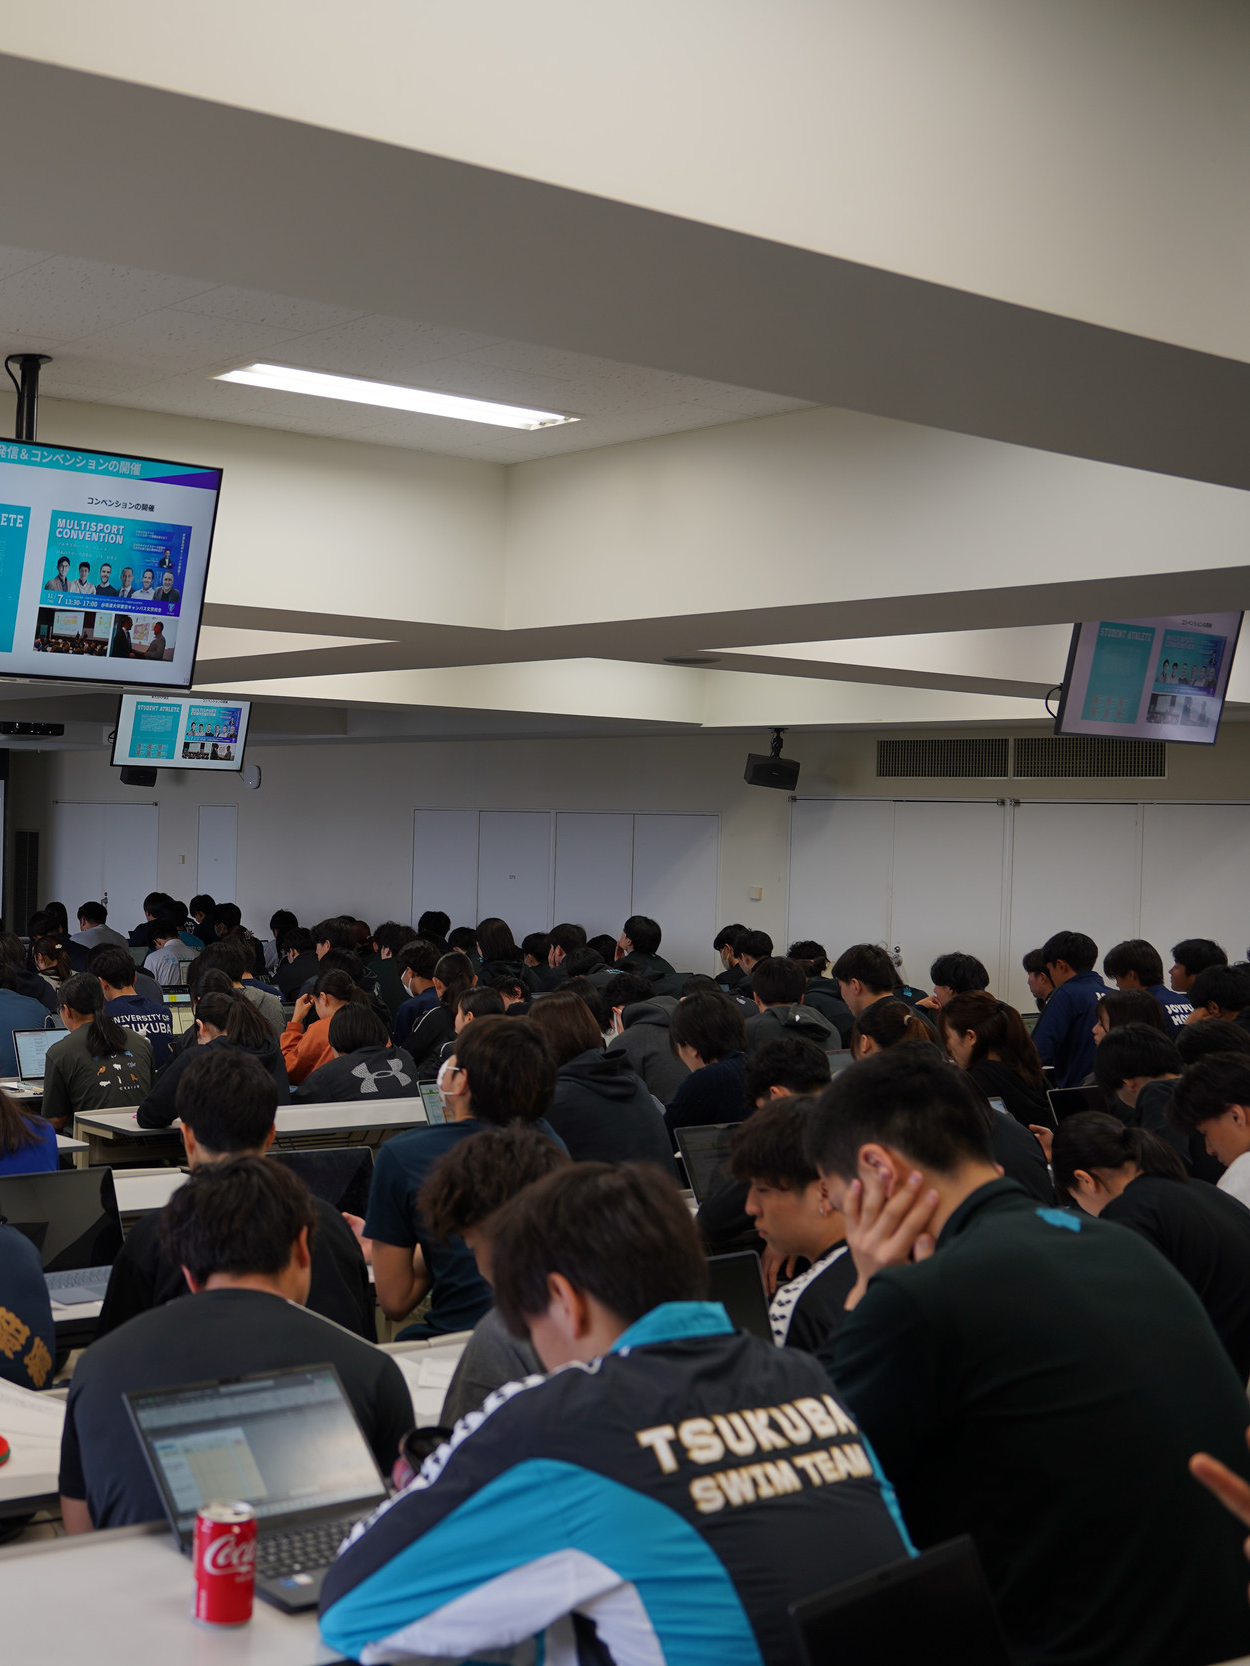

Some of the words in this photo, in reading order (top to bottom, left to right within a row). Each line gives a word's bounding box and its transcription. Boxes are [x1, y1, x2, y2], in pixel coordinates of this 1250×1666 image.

[87, 497, 156, 513] コンベンションの開催
[56, 518, 125, 535] MULTISPORT
[55, 528, 125, 545] CONVENTION
[112, 1014, 161, 1024] NIVERSITY
[635, 1393, 858, 1475] TSUKUBA
[689, 1458, 803, 1515] SWIM
[792, 1442, 873, 1488] TEAM
